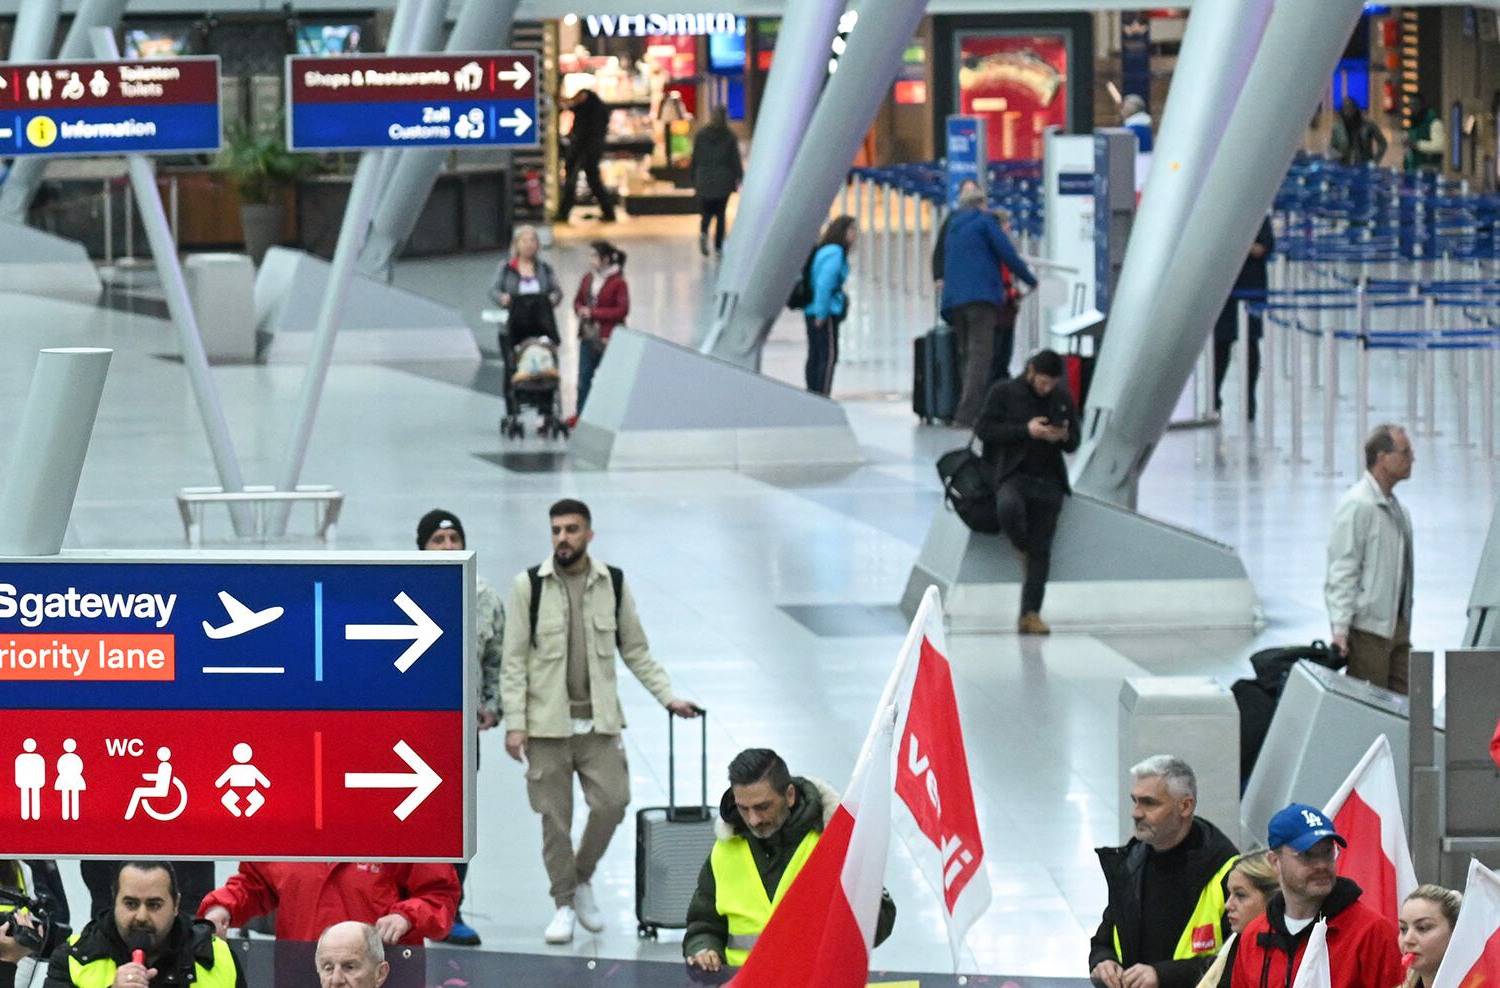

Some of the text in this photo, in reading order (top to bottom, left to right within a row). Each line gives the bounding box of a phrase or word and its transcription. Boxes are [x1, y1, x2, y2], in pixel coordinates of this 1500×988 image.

[119, 66, 180, 82] Toiletten
[304, 70, 450, 88] Shops & Restaurants
[119, 82, 164, 97] Toilets
[422, 107, 450, 123] Zoll
[61, 118, 156, 139] Information
[388, 124, 450, 140] Customs
[99, 641, 165, 669] lane
[106, 739, 144, 757] WC
[1301, 810, 1323, 827] LA
